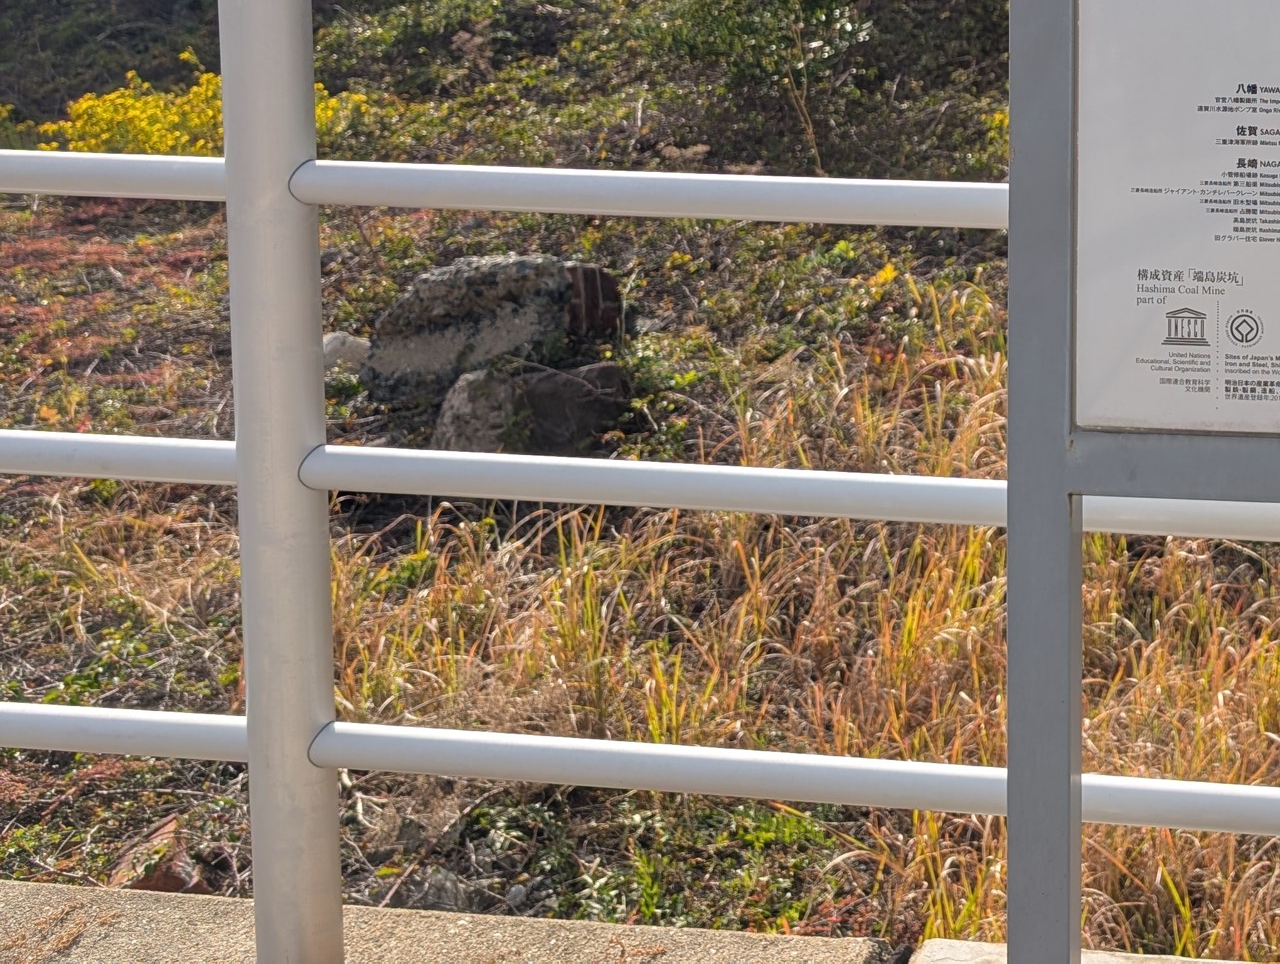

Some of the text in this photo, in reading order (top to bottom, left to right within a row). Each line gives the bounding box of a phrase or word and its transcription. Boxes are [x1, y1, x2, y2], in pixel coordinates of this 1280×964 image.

[1236, 84, 1257, 94] 八幡
[1236, 125, 1258, 136] 佐賀
[1236, 158, 1258, 169] 長崎
[1137, 268, 1243, 286] 構成資産「端島炭坑」
[1137, 284, 1225, 295] Hashima Coal Mine
[1136, 296, 1167, 306] part of
[1168, 318, 1204, 338] UNESCO
[1252, 361, 1269, 369] Steel,
